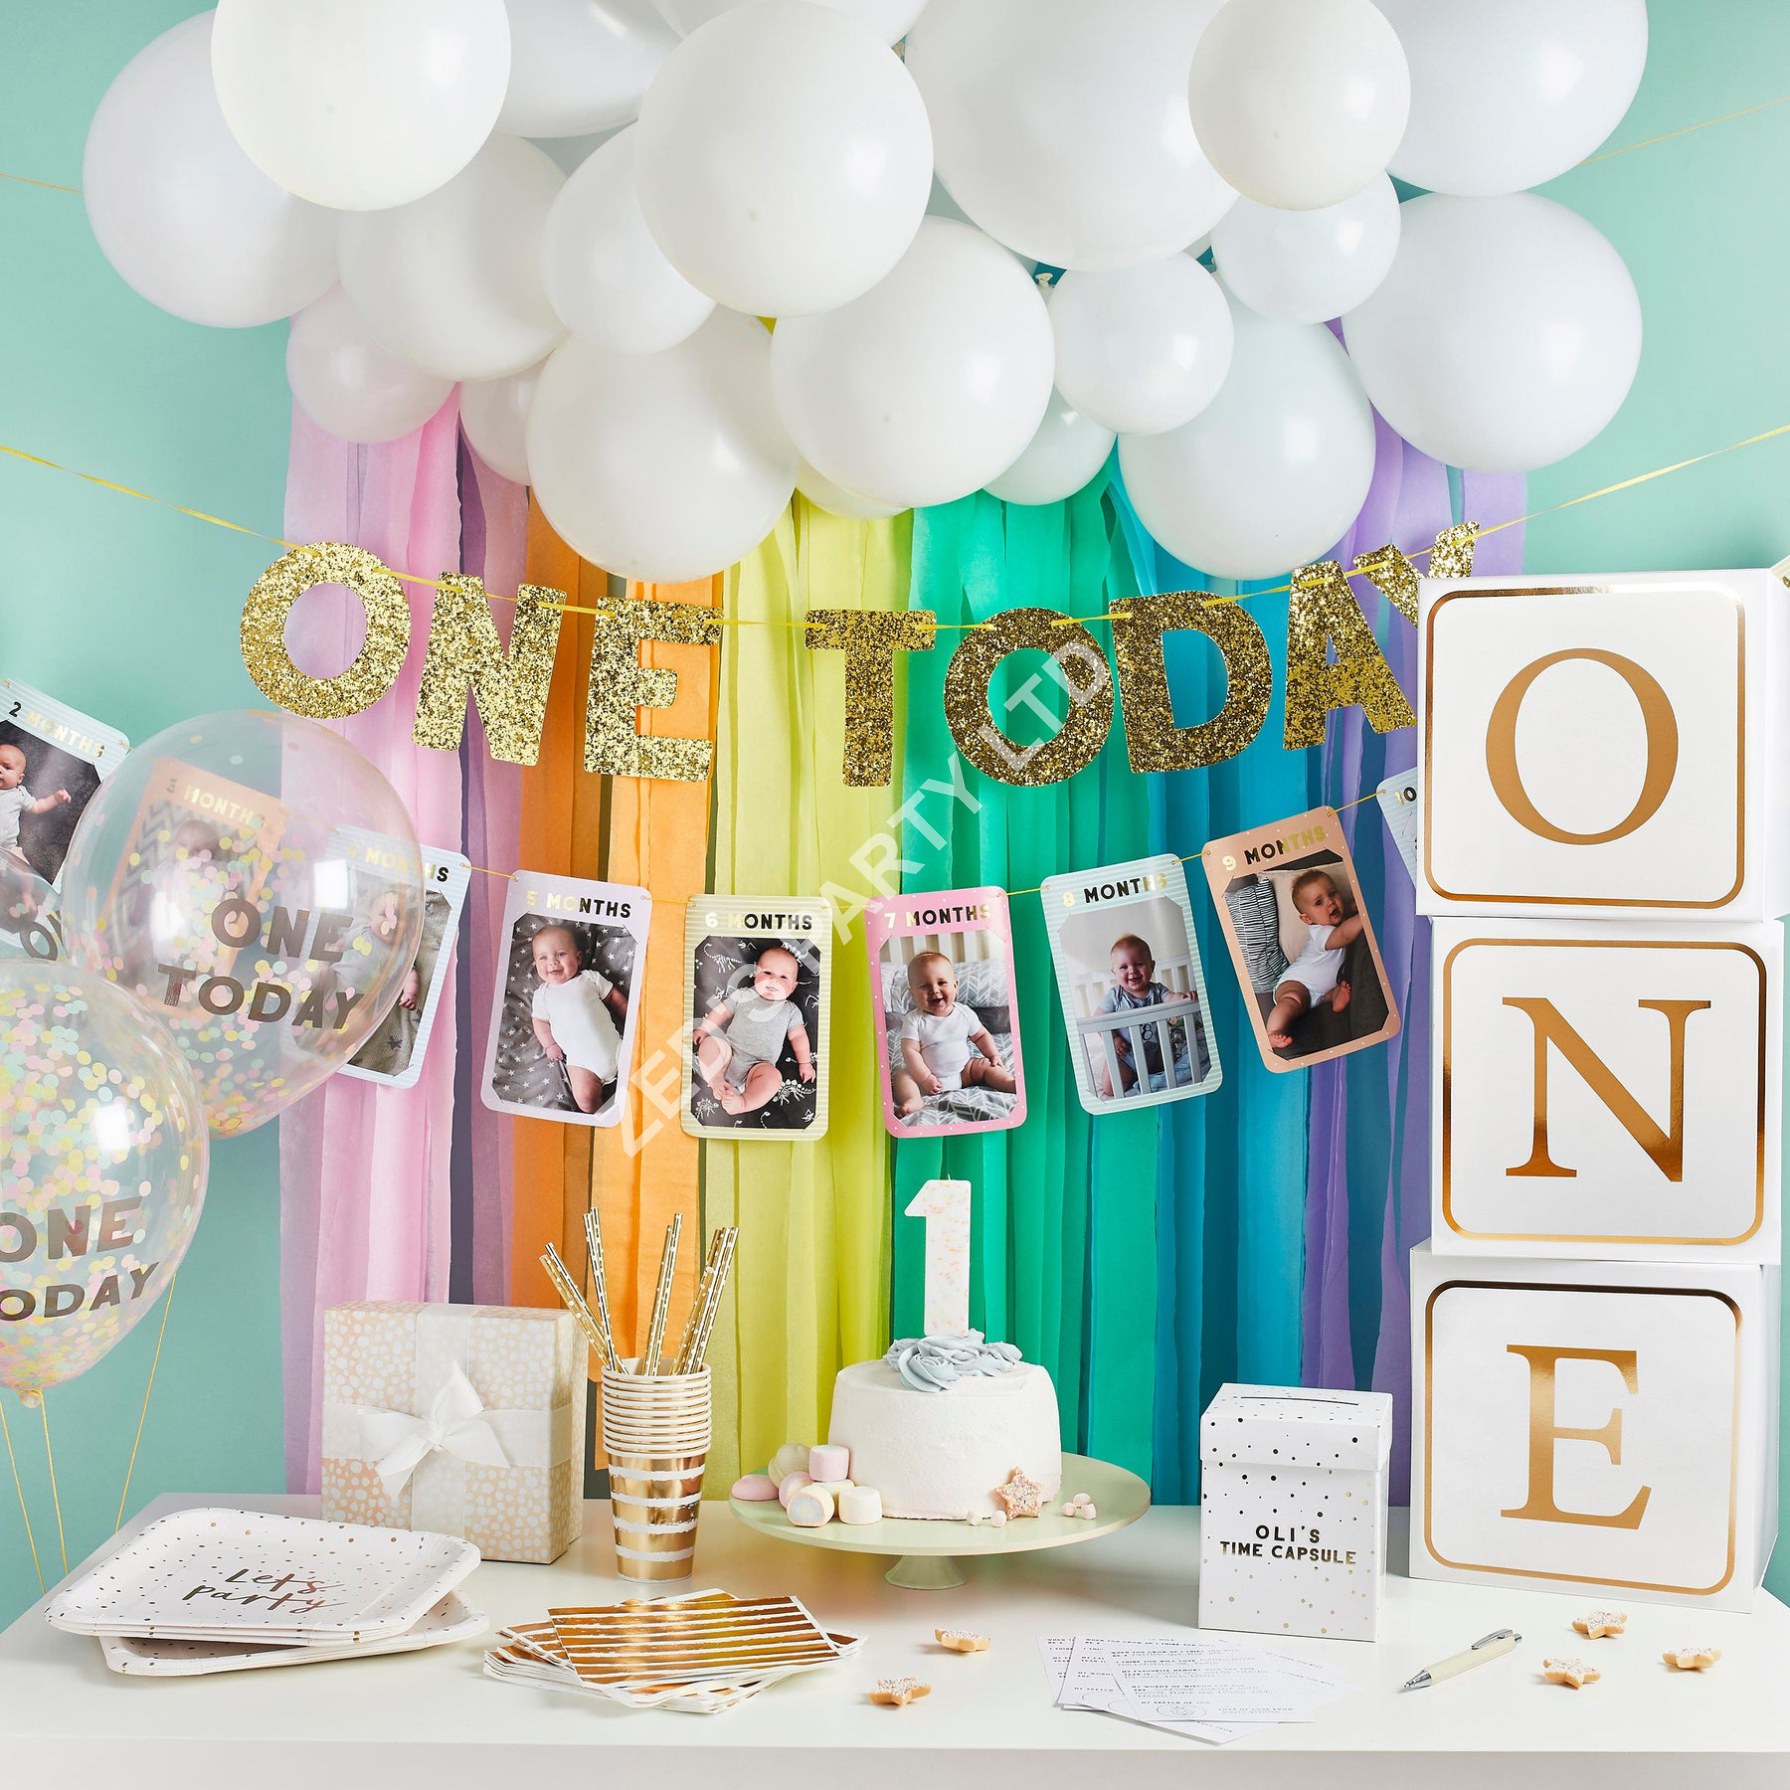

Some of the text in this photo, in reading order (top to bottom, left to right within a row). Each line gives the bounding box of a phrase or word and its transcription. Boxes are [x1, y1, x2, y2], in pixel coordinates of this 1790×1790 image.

[240, 541, 724, 782] ONE
[9, 701, 106, 758] 2 MONTHS
[1222, 825, 1326, 871] 9 MONTHS
[526, 890, 632, 918] 5 MONTHS
[1063, 872, 1168, 908] 8 MONTHS
[211, 898, 354, 962] ONE
[705, 911, 813, 930] 6 MONTHS
[884, 904, 991, 929] 7 MONTHS
[157, 964, 365, 1030] TODAY
[1255, 1525, 1320, 1543] OLI'S
[1220, 1541, 1357, 1565] TIME CAPSULE
[182, 1585, 348, 1614] party
